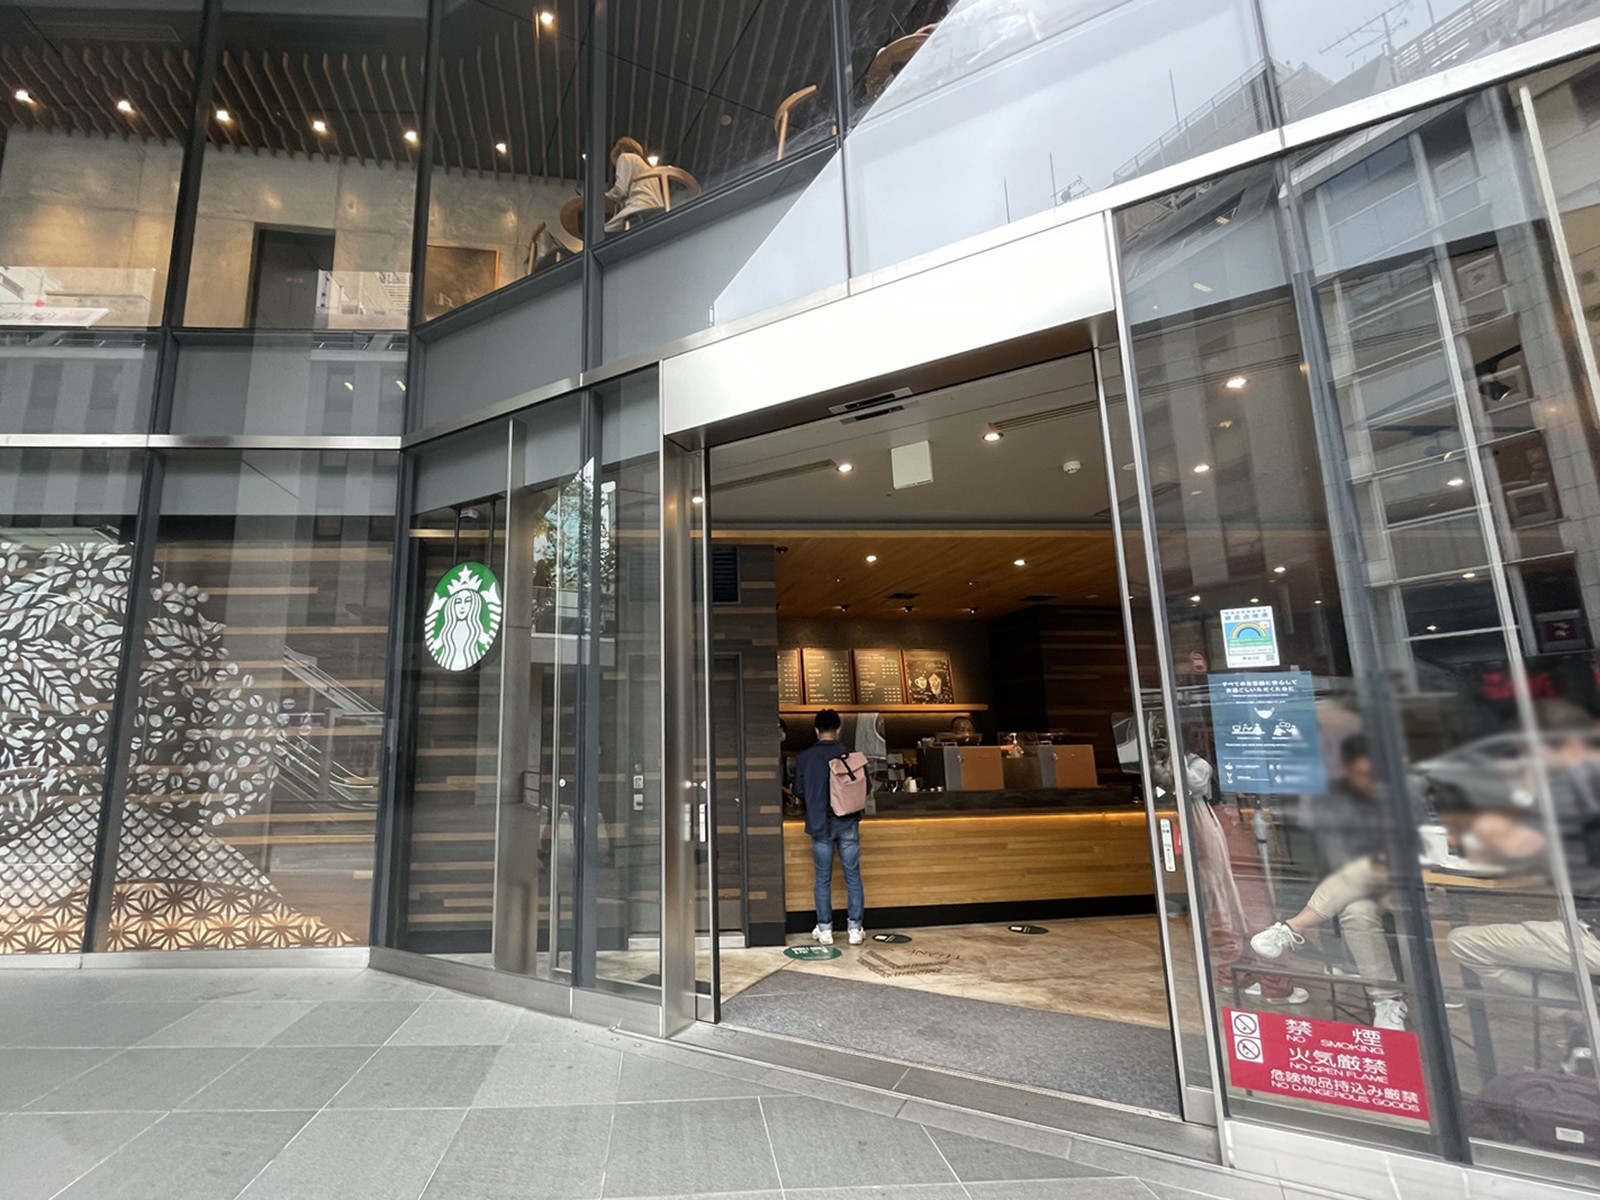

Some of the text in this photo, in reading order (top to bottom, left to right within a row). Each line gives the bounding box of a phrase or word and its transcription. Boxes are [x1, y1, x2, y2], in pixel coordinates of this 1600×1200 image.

[1285, 1019, 1383, 1047] 禁 煙
[1286, 1034, 1385, 1055] NO SMOKING
[1289, 1047, 1388, 1075] 火気厳禁
[1289, 1062, 1389, 1084] NO OPEN FLAME
[1270, 1069, 1419, 1105] 危険物品持込み厳禁
[1271, 1080, 1420, 1112] NO DANGEROUS GOODS
